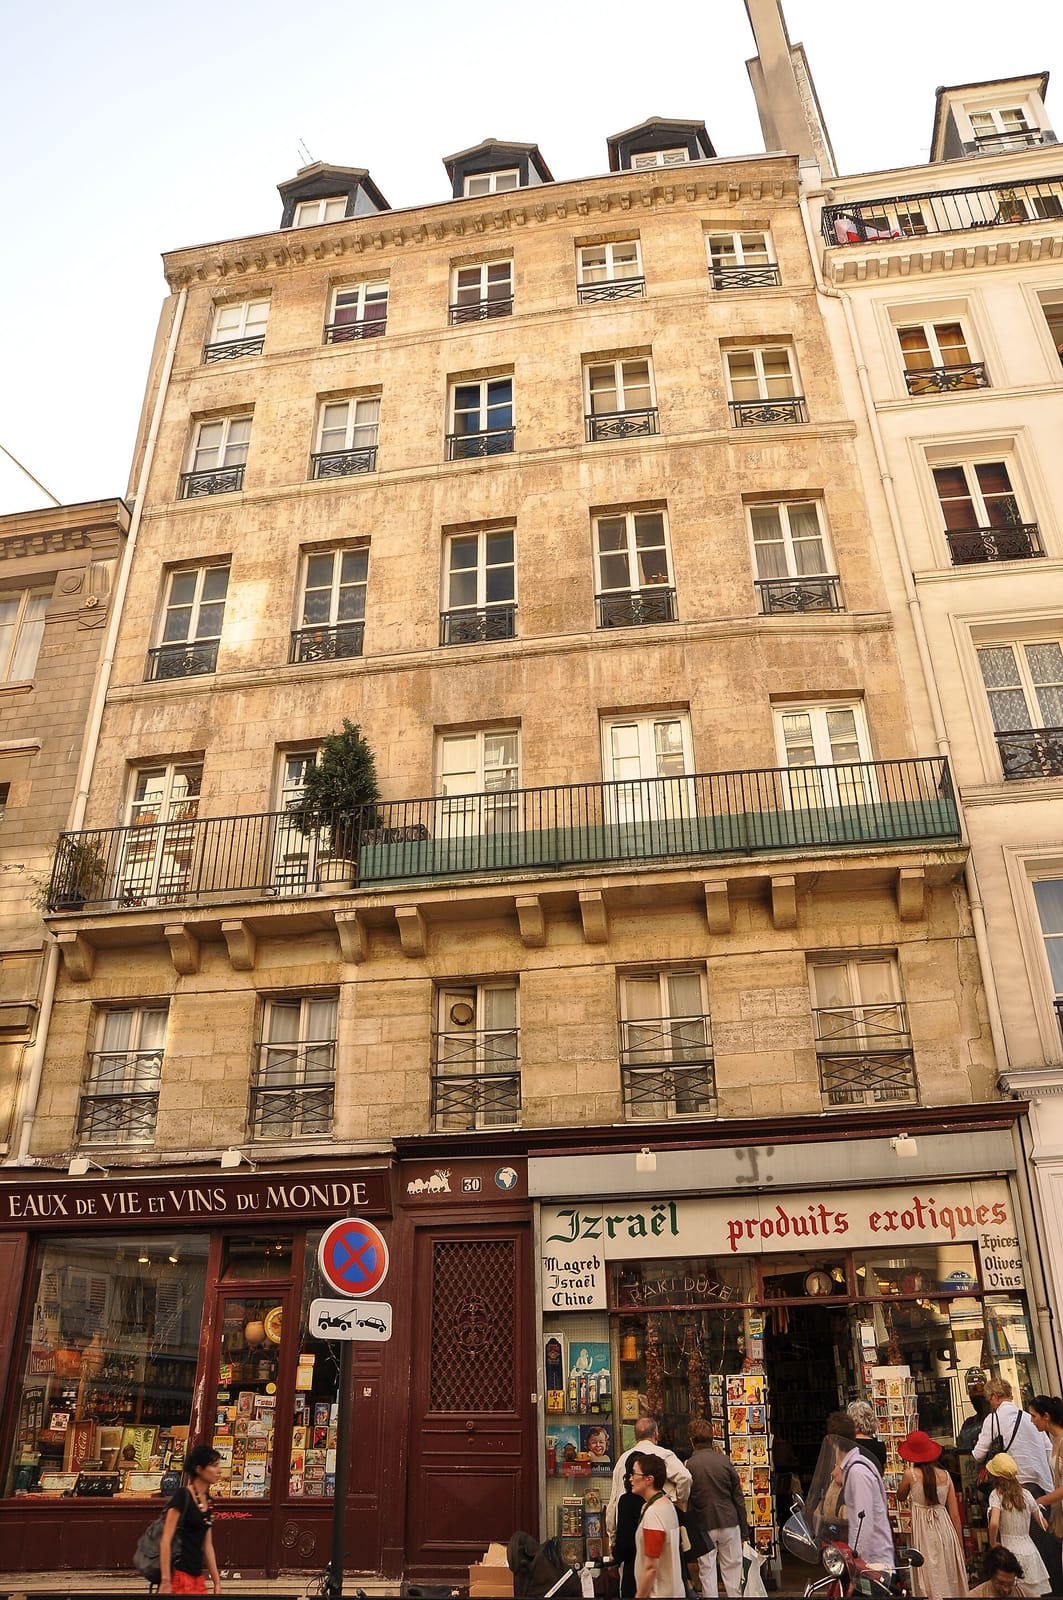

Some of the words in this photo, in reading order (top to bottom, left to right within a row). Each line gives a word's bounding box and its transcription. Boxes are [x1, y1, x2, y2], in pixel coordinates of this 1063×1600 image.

[463, 1179, 480, 1191] 30
[9, 1194, 69, 1217] EAUX
[75, 1199, 97, 1215] DE
[101, 1192, 142, 1214] VIE
[148, 1196, 166, 1213] ET
[168, 1188, 227, 1212] VINS
[236, 1193, 260, 1210] DU
[265, 1182, 369, 1209] MONDE
[545, 1200, 680, 1243] Izraël
[726, 1204, 850, 1252] produits
[868, 1196, 1008, 1240] exotiques
[541, 1254, 601, 1275] Magreb
[984, 1255, 1023, 1271] Olives
[988, 1272, 1021, 1287] Vins
[551, 1291, 594, 1307] Chine
[629, 1277, 676, 1304] RAKI
